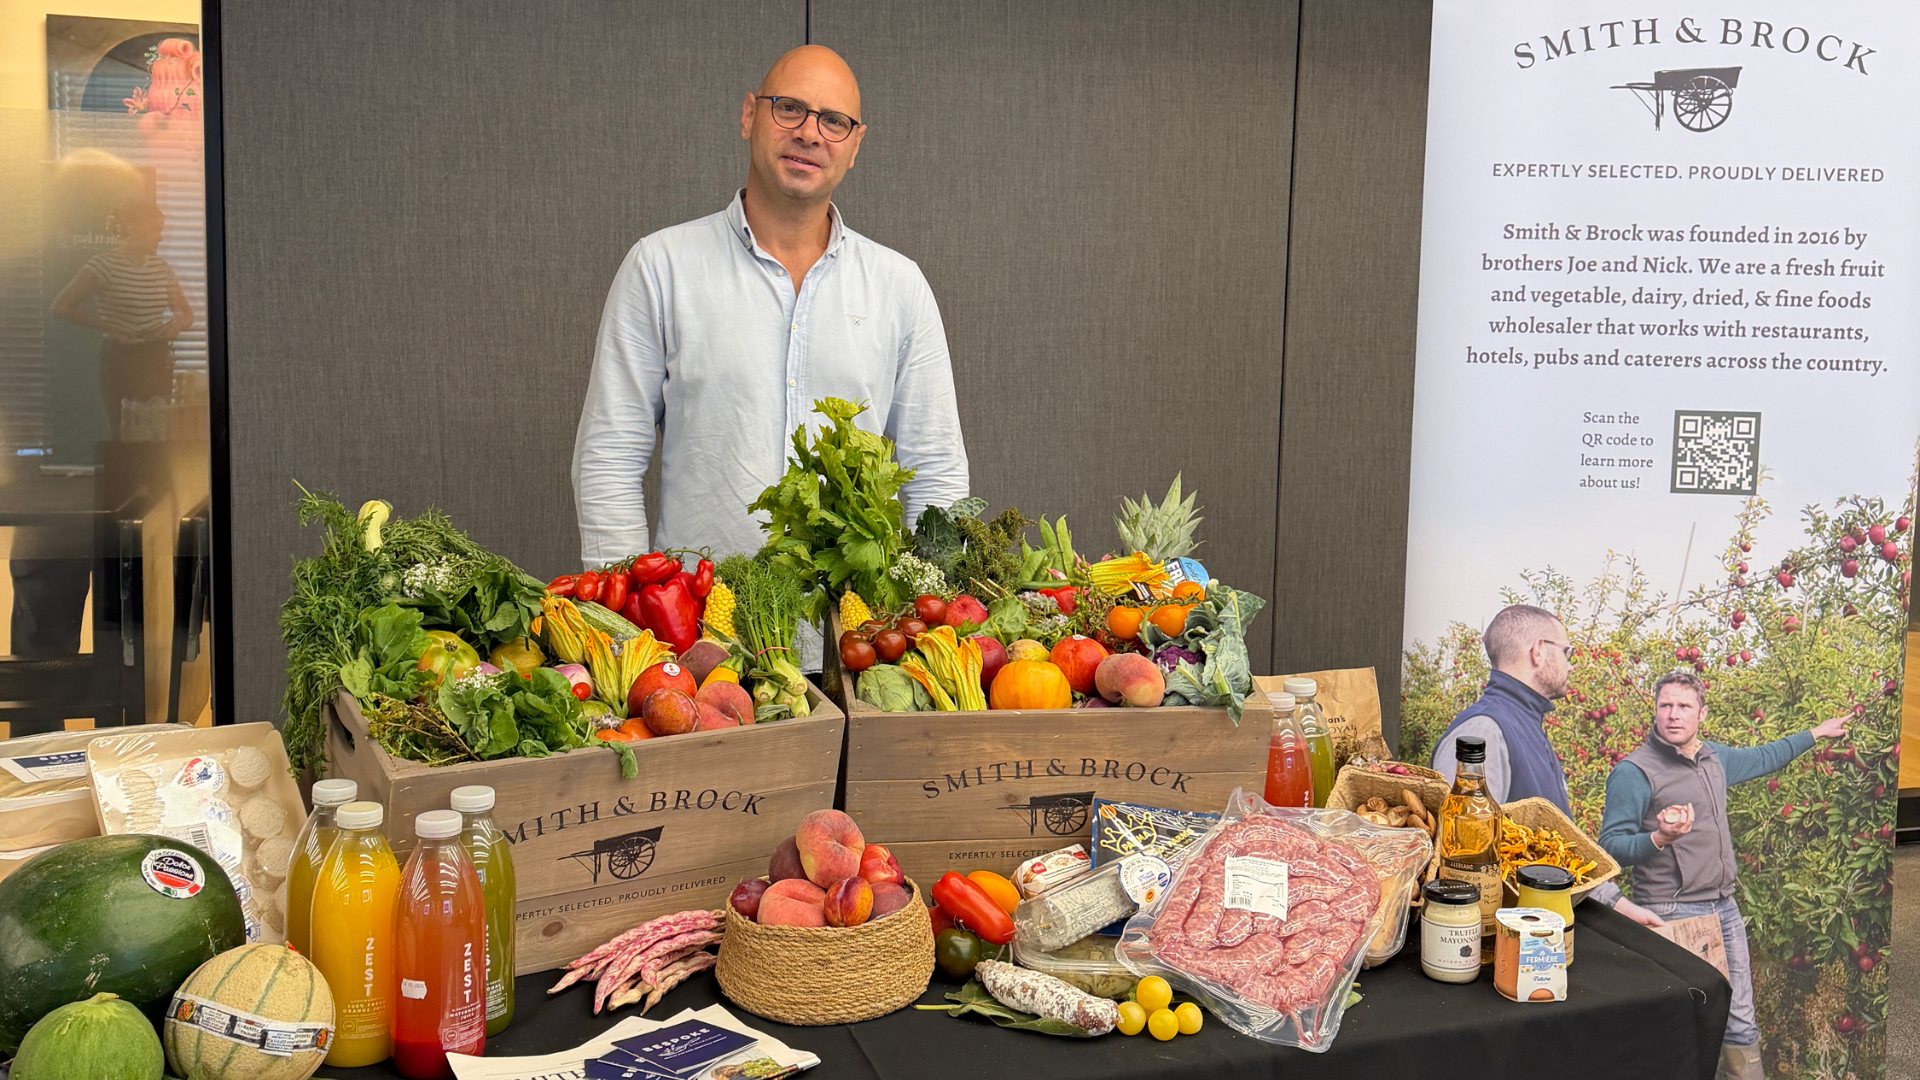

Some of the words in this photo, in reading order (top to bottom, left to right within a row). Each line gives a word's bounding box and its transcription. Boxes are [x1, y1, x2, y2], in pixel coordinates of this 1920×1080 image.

[1513, 17, 1661, 69] SMITH
[1675, 17, 1707, 44] &
[1719, 17, 1878, 76] BROCK
[1492, 163, 1583, 178] EXPERTLY
[1587, 164, 1683, 180] SELECTED.
[1688, 165, 1777, 181] PROUDLY
[1781, 167, 1884, 183] DELIVERED
[1503, 222, 1560, 241] Smith
[1564, 224, 1582, 241] &
[1585, 223, 1644, 242] Brock
[1647, 229, 1685, 242] was
[1688, 224, 1770, 244] founded
[1773, 226, 1794, 244] in
[1797, 230, 1840, 245] 2016
[1843, 227, 1868, 251] by
[1481, 252, 1563, 272] brothers
[1566, 255, 1598, 275] Joe
[1601, 254, 1639, 273] and
[1642, 255, 1693, 274] Nick.
[1697, 257, 1731, 275] We
[1734, 262, 1766, 276] are
[1770, 263, 1781, 276] a
[1785, 257, 1836, 277] fresh
[1839, 258, 1885, 278] fruit
[1490, 284, 1527, 303] and
[1530, 285, 1627, 309] vegetable,
[1631, 286, 1688, 310] dairy,
[1692, 287, 1750, 309] dried,
[1754, 290, 1772, 308] &
[1774, 288, 1813, 308] fine
[1817, 289, 1872, 309] foods
[1488, 315, 1593, 335] wholesaler
[1596, 317, 1636, 336] that
[1639, 318, 1699, 337] works
[1702, 319, 1747, 338] with
[1751, 325, 1869, 344] restaurants,
[1466, 345, 1529, 367] hotels,
[1533, 347, 1579, 370] pubs
[1583, 348, 1620, 366] and
[1623, 353, 1702, 368] caterers
[1706, 356, 1767, 370] across
[1771, 351, 1803, 371] the
[1806, 358, 1888, 378] country.
[1582, 411, 1616, 424] Scan
[1618, 411, 1640, 425] the
[1581, 432, 1604, 448] QR
[1605, 432, 1638, 446] code
[1640, 436, 1654, 447] to
[1580, 453, 1615, 467] learn
[1618, 458, 1654, 468] more
[1579, 474, 1618, 489] about
[1620, 476, 1641, 489] us!
[922, 759, 1034, 799] SMITH
[1046, 758, 1070, 777] &
[1080, 758, 1194, 795] BROCK
[502, 800, 601, 846] MITH
[613, 795, 639, 817] &
[649, 789, 766, 816] BROCK
[1121, 830, 1151, 852] PAMA
[949, 852, 997, 860] EXPERTLY
[516, 906, 555, 922] PERTLY
[618, 886, 668, 901] PROUDLY
[671, 875, 726, 892] DELIVERED
[364, 937, 375, 997] ZEST
[464, 942, 472, 1003] ZEST
[641, 1027, 711, 1053] BESPOKE
